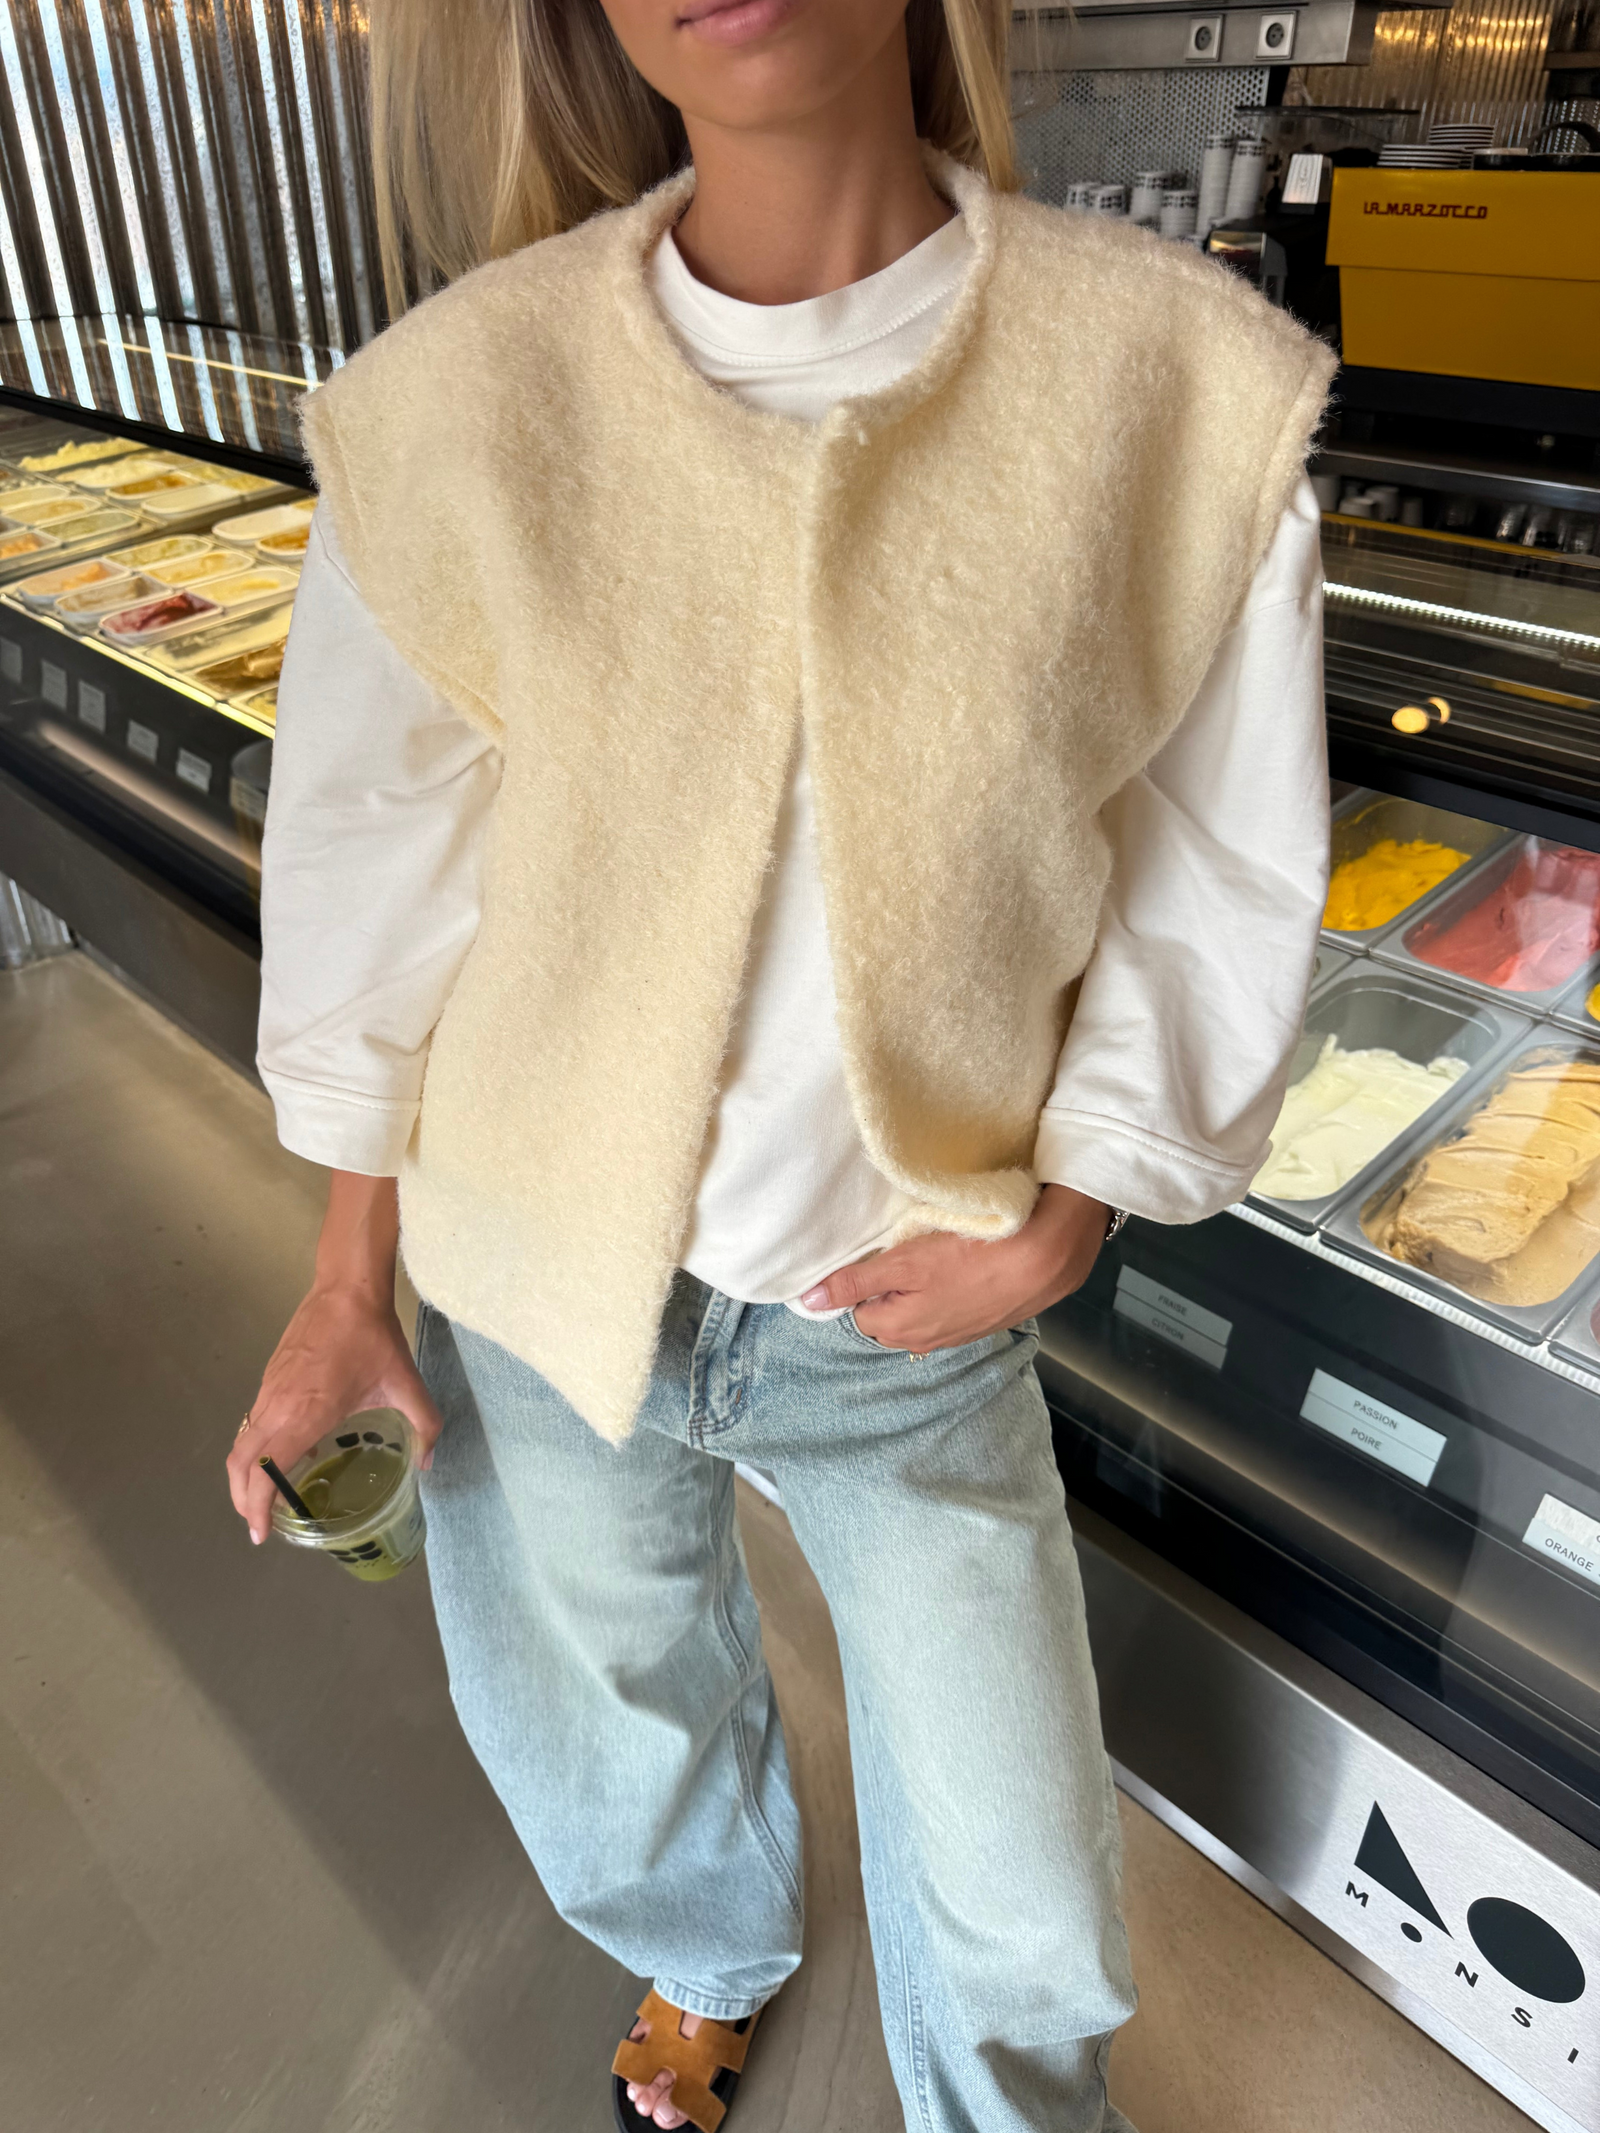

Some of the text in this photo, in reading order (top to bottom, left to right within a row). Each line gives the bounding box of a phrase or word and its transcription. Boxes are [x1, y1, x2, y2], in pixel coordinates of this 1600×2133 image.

[1364, 202, 1488, 219] LA MARZOCCO
[1158, 1295, 1188, 1316] FRAISE
[1151, 1318, 1185, 1340] CITRON
[1353, 1400, 1398, 1430] PASSION
[1350, 1428, 1383, 1451] POIRE
[1544, 1538, 1594, 1572] ORANGE
